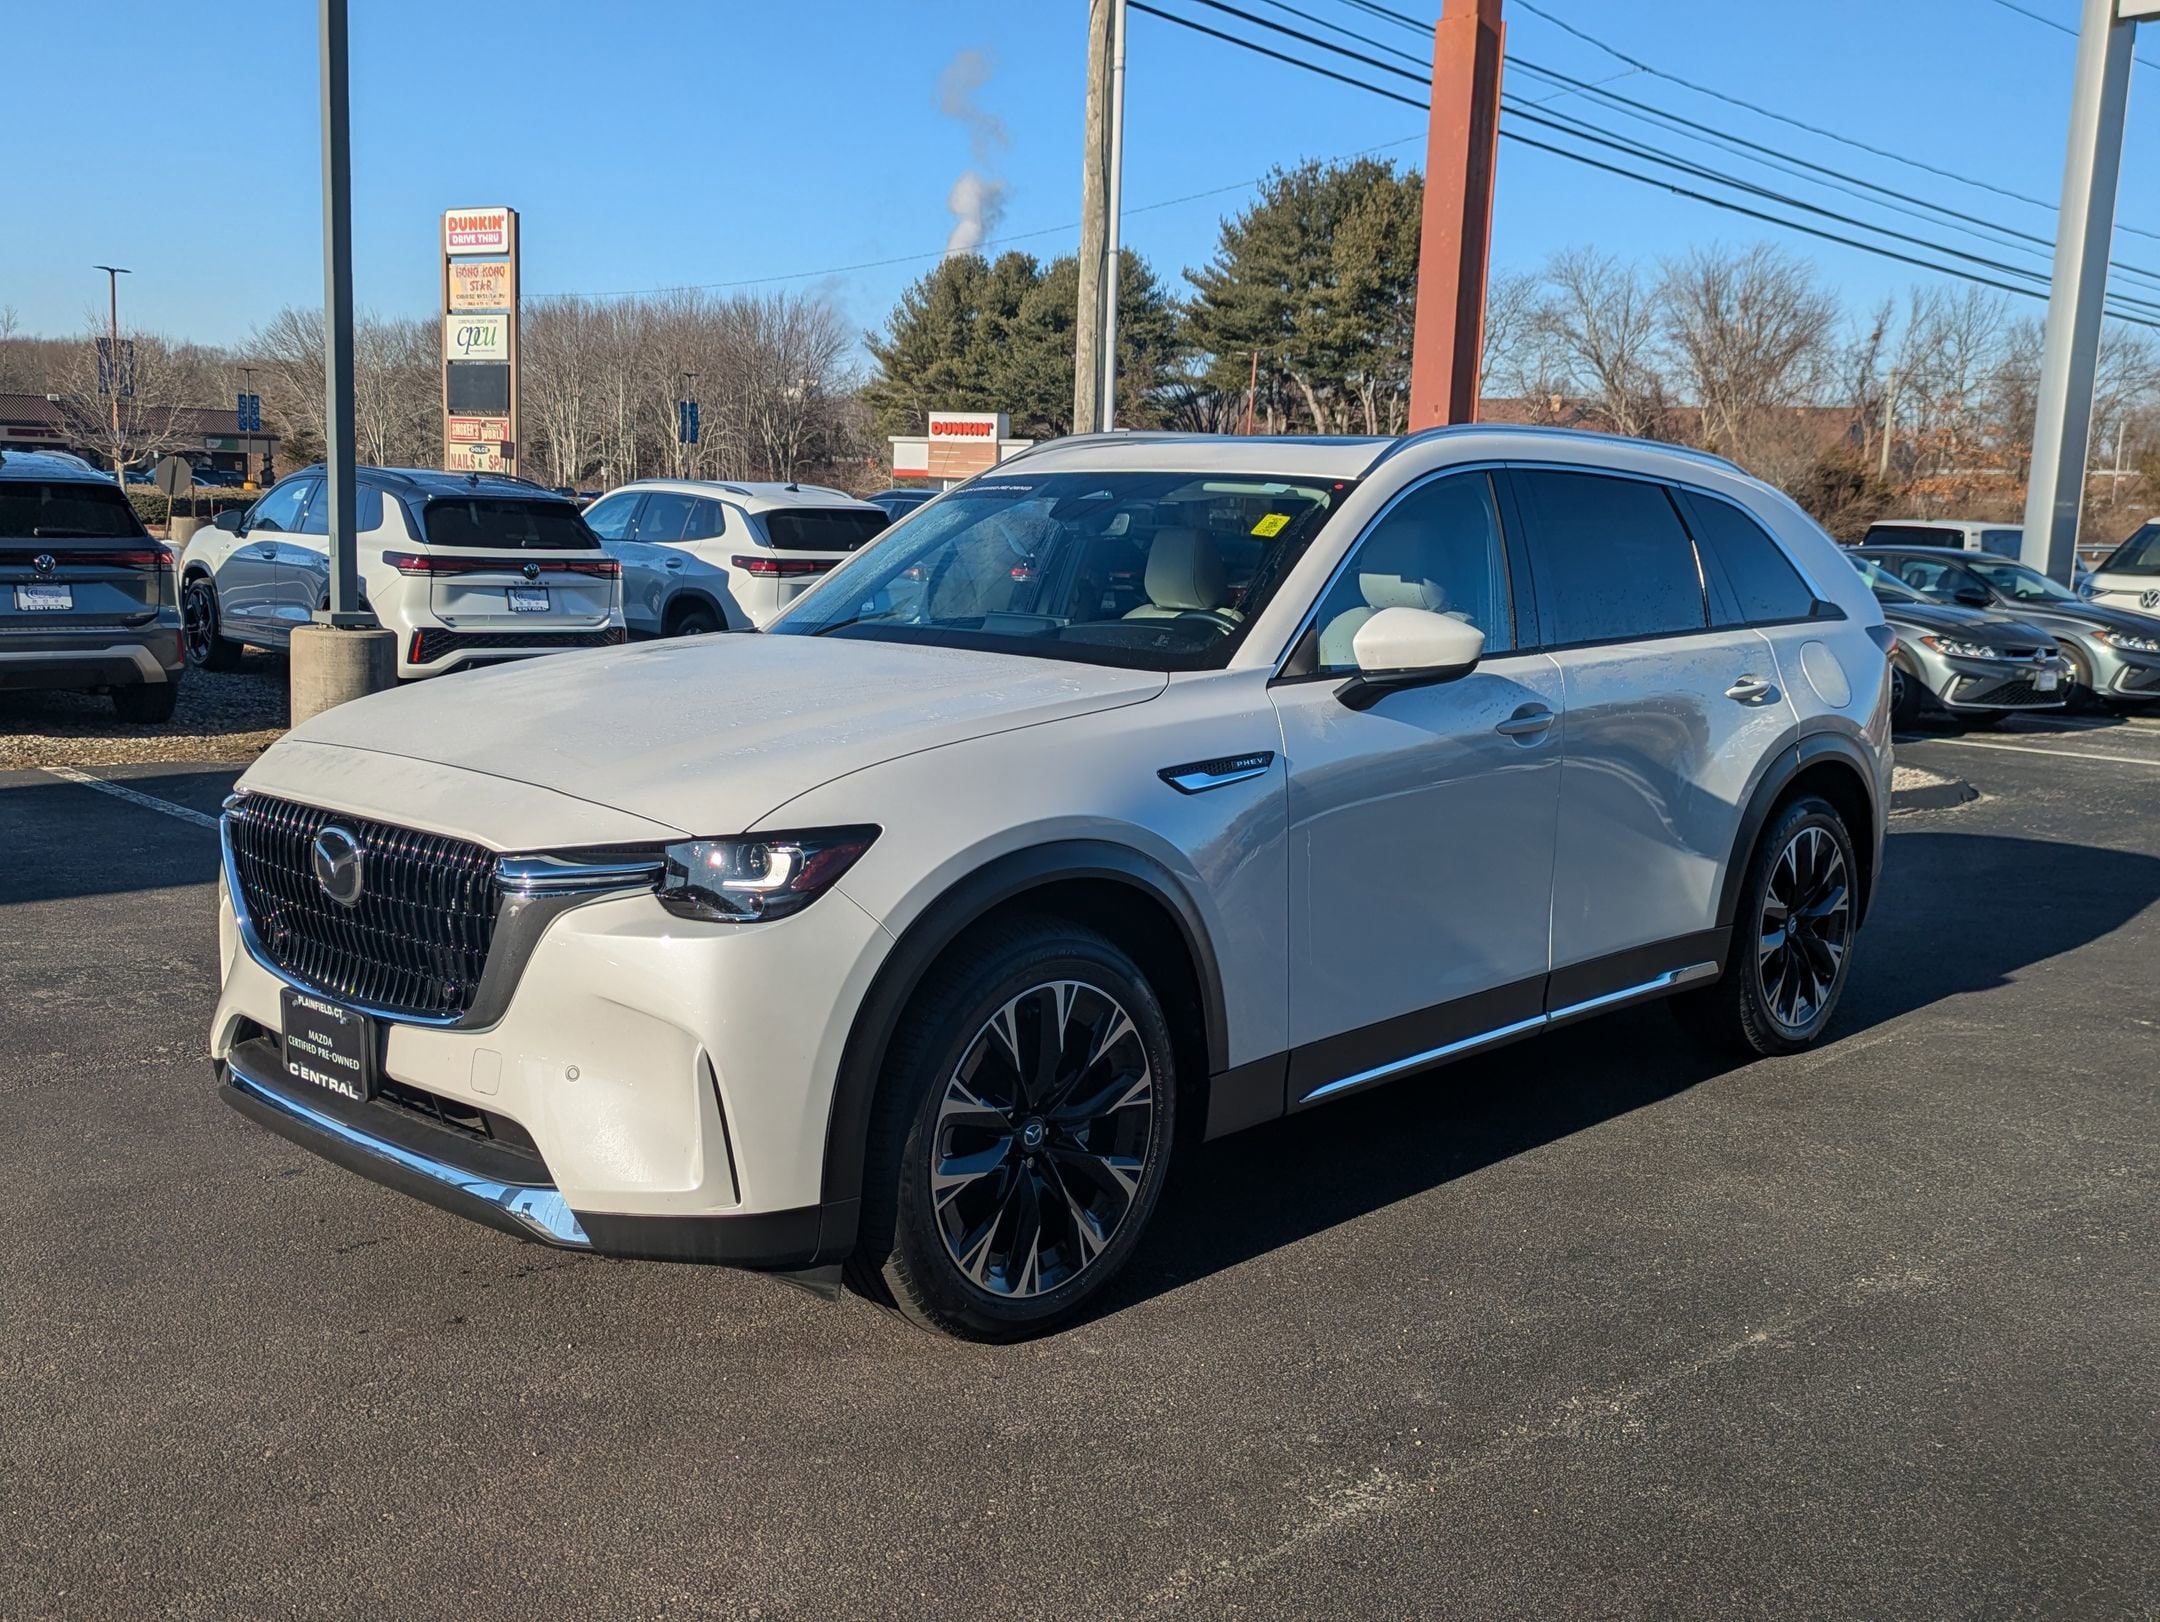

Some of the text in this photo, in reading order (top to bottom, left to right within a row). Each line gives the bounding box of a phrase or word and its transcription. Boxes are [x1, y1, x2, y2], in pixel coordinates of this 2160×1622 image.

[448, 215, 504, 232] DUNKIN'
[452, 232, 499, 244] DRIVE THRU
[456, 265, 505, 278] HONG KONG
[469, 280, 493, 291] STAR
[451, 423, 479, 437] SMOKER'S
[483, 429, 504, 440] WORLD
[931, 421, 994, 437] DUNKIN'
[451, 454, 475, 469] NAILS
[1236, 757, 1264, 768] PHEV
[308, 1029, 333, 1048] MAZDA
[287, 1034, 360, 1071] CERTIFIED PRE-OWNED
[289, 1062, 359, 1100] CENTRAL
